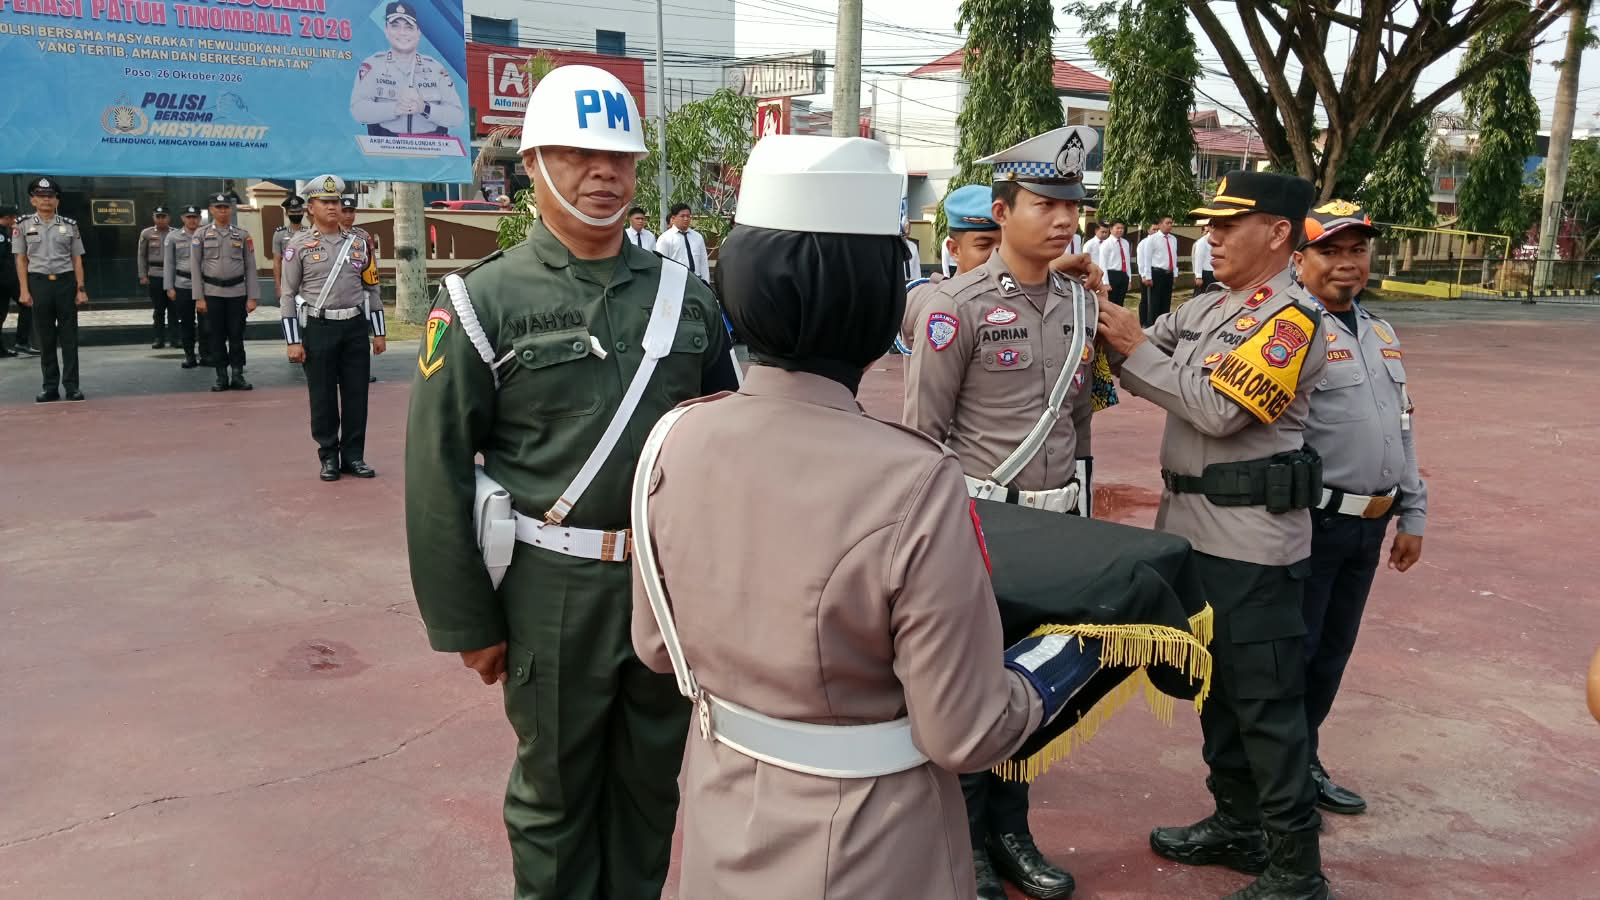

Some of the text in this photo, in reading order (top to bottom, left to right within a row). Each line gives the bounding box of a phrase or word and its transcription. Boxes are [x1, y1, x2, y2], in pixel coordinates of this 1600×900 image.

[91, 0, 167, 25] PATUH
[174, 4, 293, 36] TINOMBALA
[300, 16, 352, 40] 2026
[38, 26, 104, 42] BERSAMA
[107, 32, 194, 48] MASYARAKAT
[198, 39, 281, 54] MEWUJUDKAN
[283, 46, 352, 60] LALULINTAS
[38, 40, 76, 53] YANG
[79, 44, 129, 58] TERTIB,
[131, 47, 169, 60] AMAN
[171, 52, 197, 62] DAN
[157, 69, 170, 79] 26
[172, 70, 217, 81] Oktober
[219, 73, 243, 83] 2026
[743, 59, 811, 95] YAMAHA
[141, 92, 206, 111] POLISI
[575, 89, 631, 132] PM
[154, 110, 213, 123] BERSAMA
[149, 122, 271, 140] MASYARAKAT
[158, 139, 208, 147] MENGAYOMI
[209, 140, 227, 148] DAN
[228, 141, 268, 149] MELAYANI
[508, 309, 585, 337] WAHYU
[982, 327, 1028, 342] ADRIAN
[1244, 372, 1279, 408] OPS
